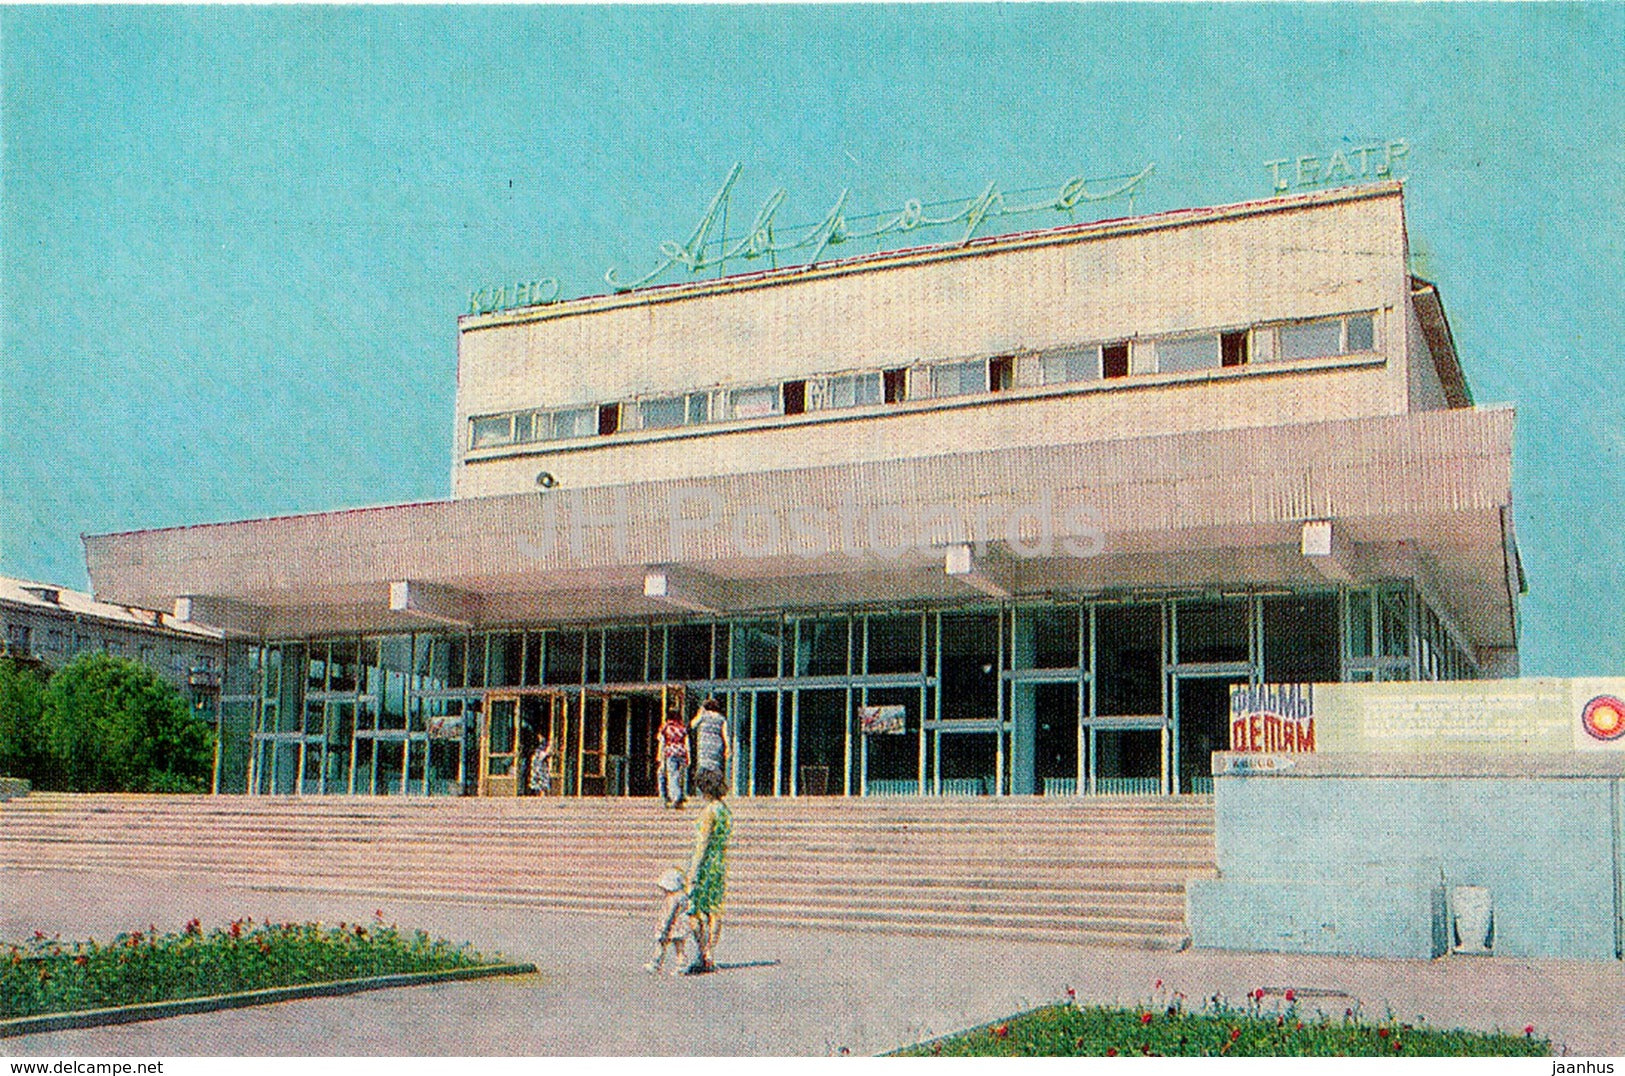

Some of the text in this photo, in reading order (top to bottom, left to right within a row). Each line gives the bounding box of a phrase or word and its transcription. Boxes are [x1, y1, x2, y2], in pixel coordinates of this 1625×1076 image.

[1264, 138, 1410, 191] ТЕАТР
[469, 276, 560, 314] КИНО
[1233, 714, 1316, 753] ДЕТЯМ
